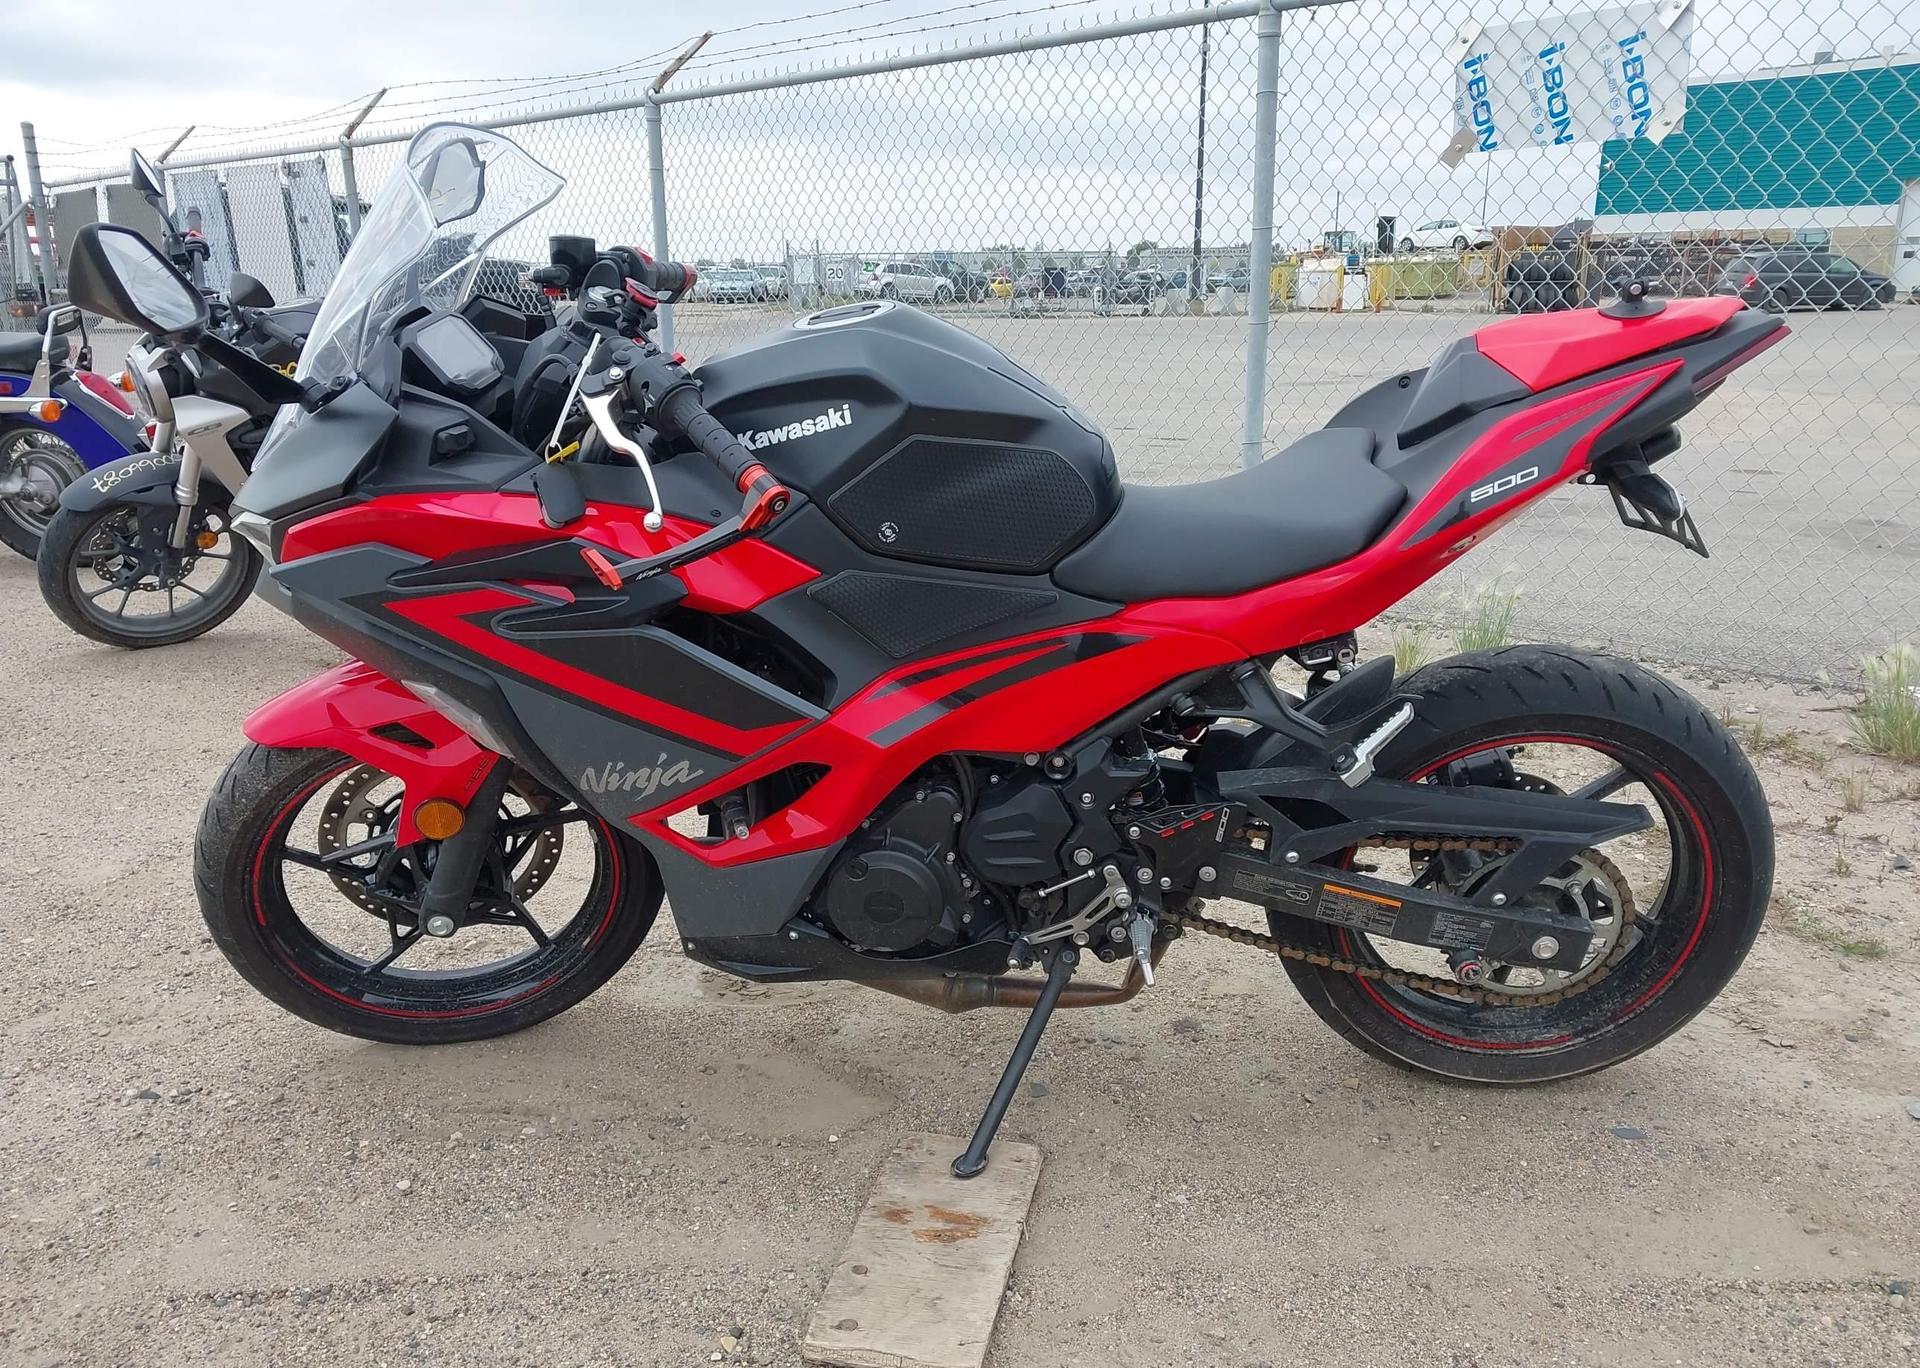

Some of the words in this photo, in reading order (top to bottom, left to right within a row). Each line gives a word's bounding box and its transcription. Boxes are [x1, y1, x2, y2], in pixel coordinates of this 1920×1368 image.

[827, 267, 844, 280] 20
[737, 404, 852, 451] Kawasaki
[1470, 466, 1539, 503] 500
[579, 752, 704, 801] Ninja
